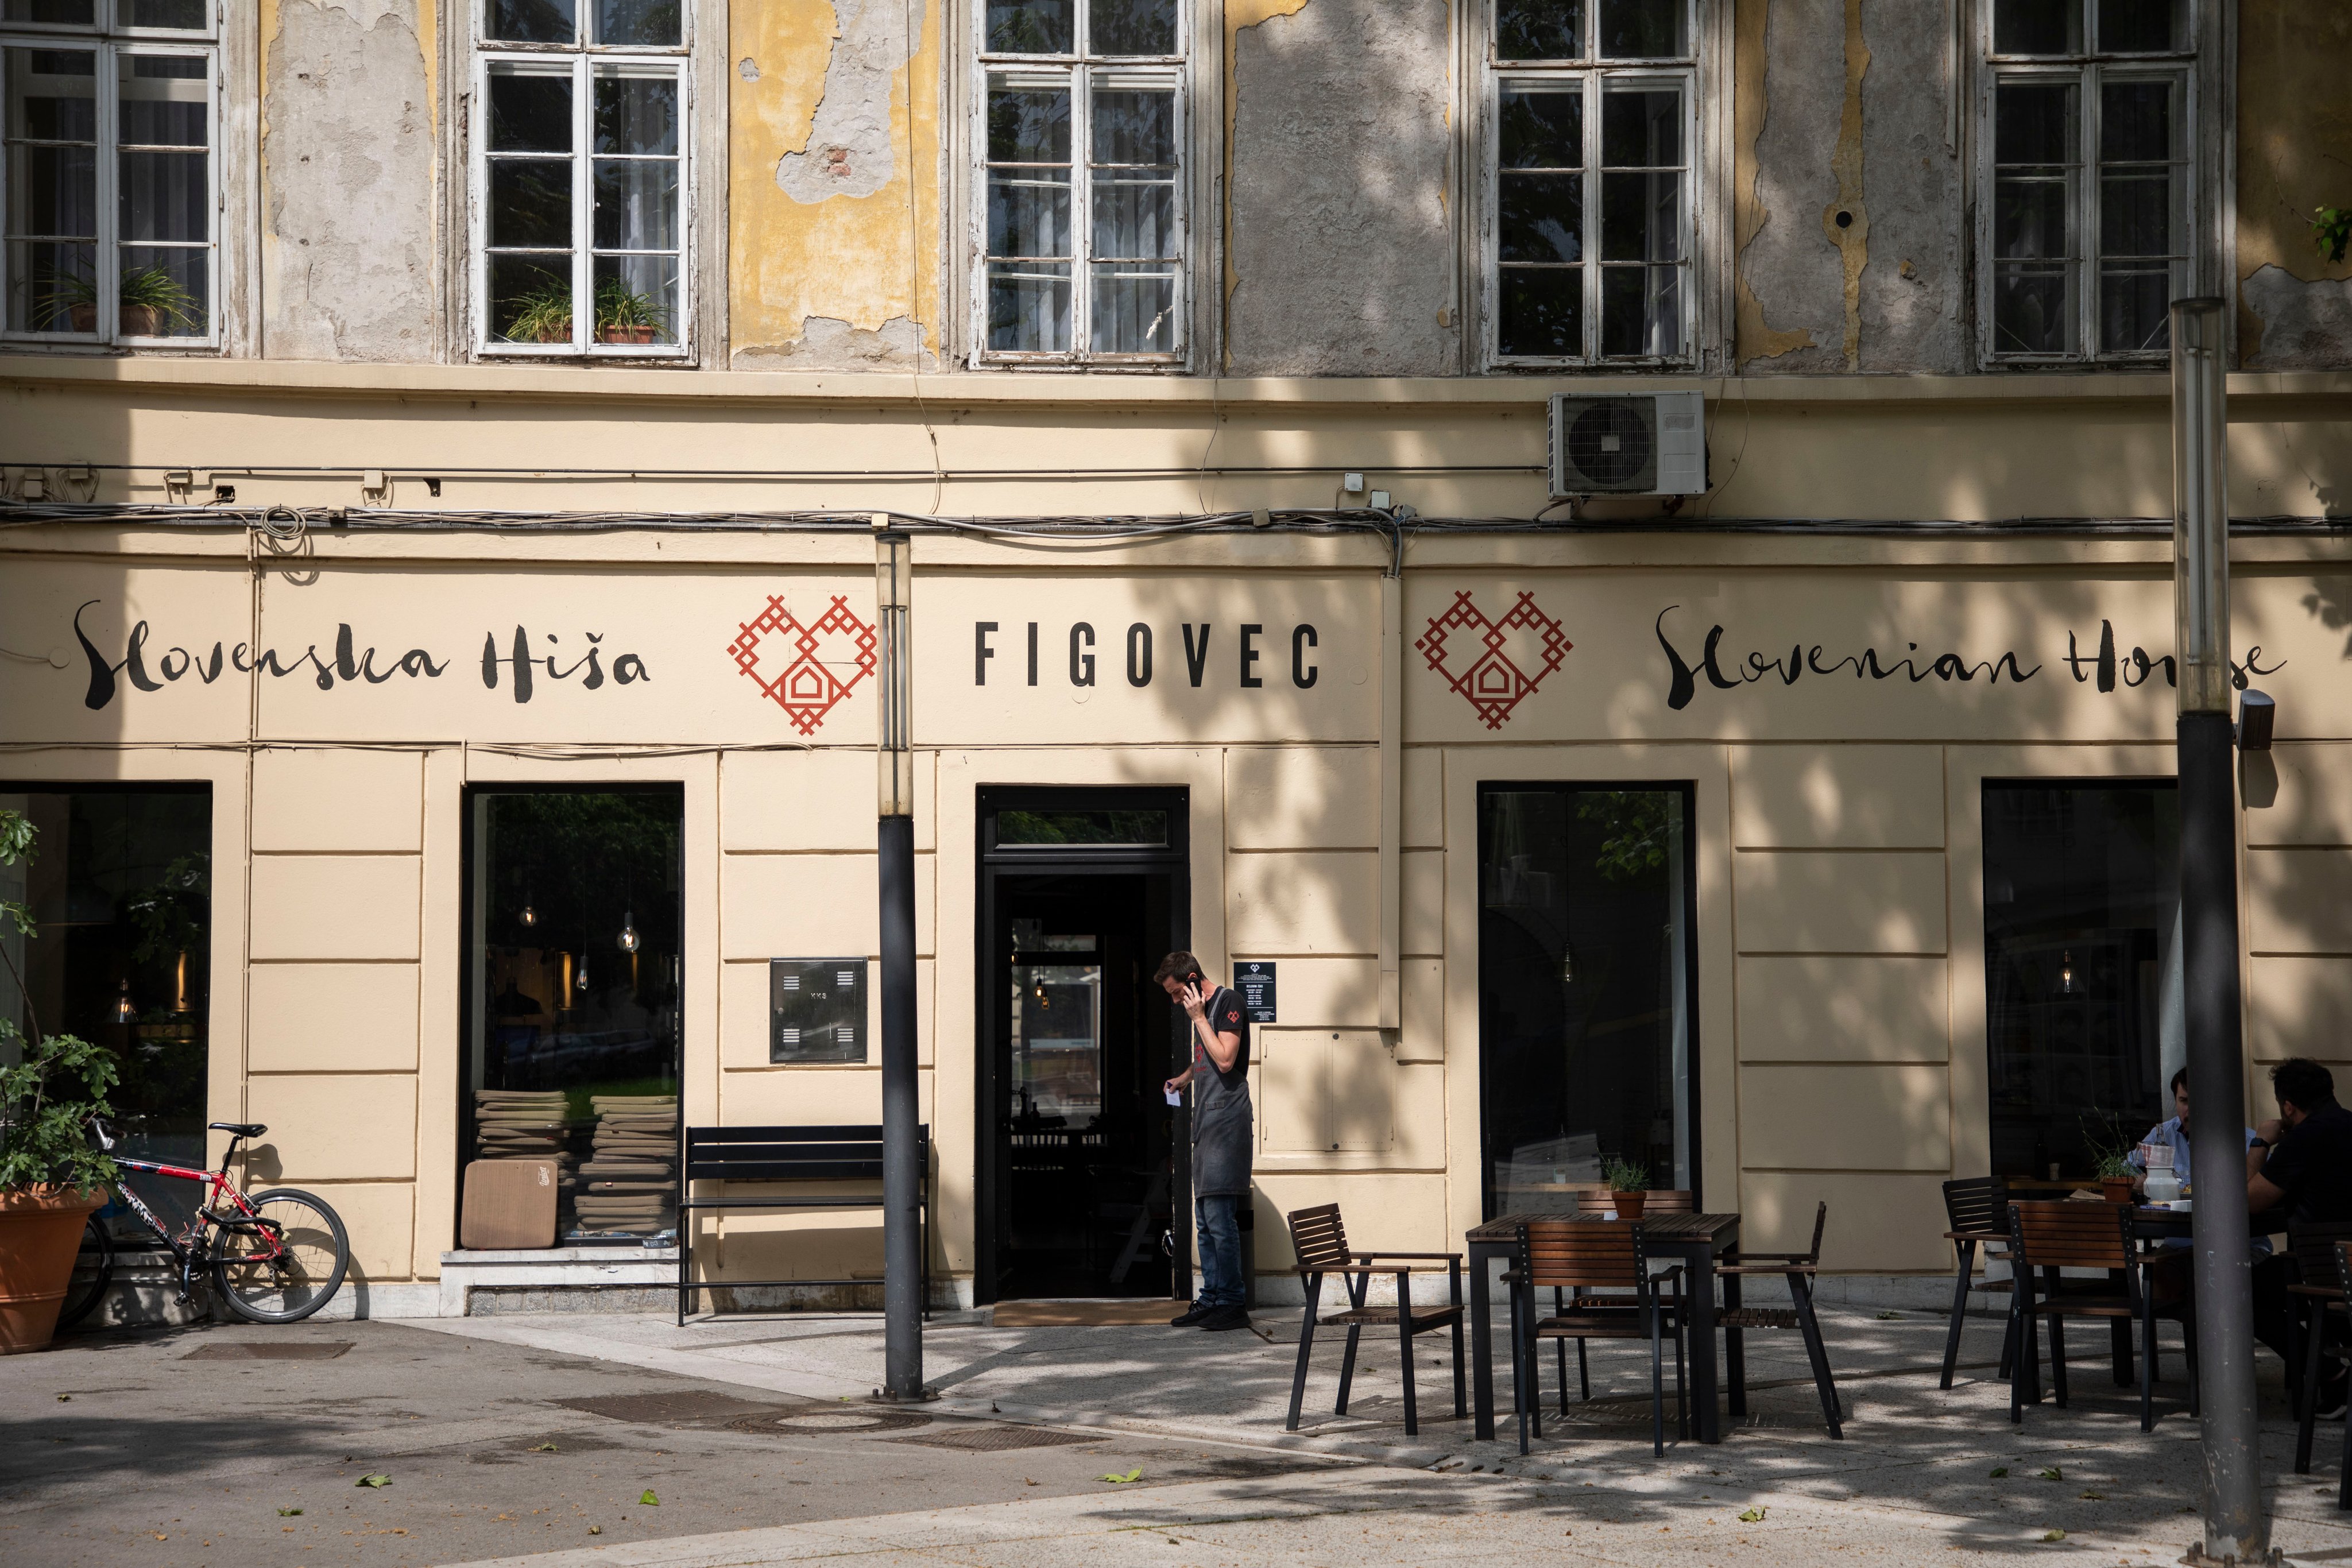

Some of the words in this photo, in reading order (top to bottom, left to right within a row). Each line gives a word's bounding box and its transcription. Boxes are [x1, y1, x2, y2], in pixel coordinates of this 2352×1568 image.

[74, 599, 451, 711] Slovenska
[479, 624, 651, 704] Hiša
[976, 622, 1318, 689] FIGOVEC
[1655, 605, 2044, 711] Slovenian
